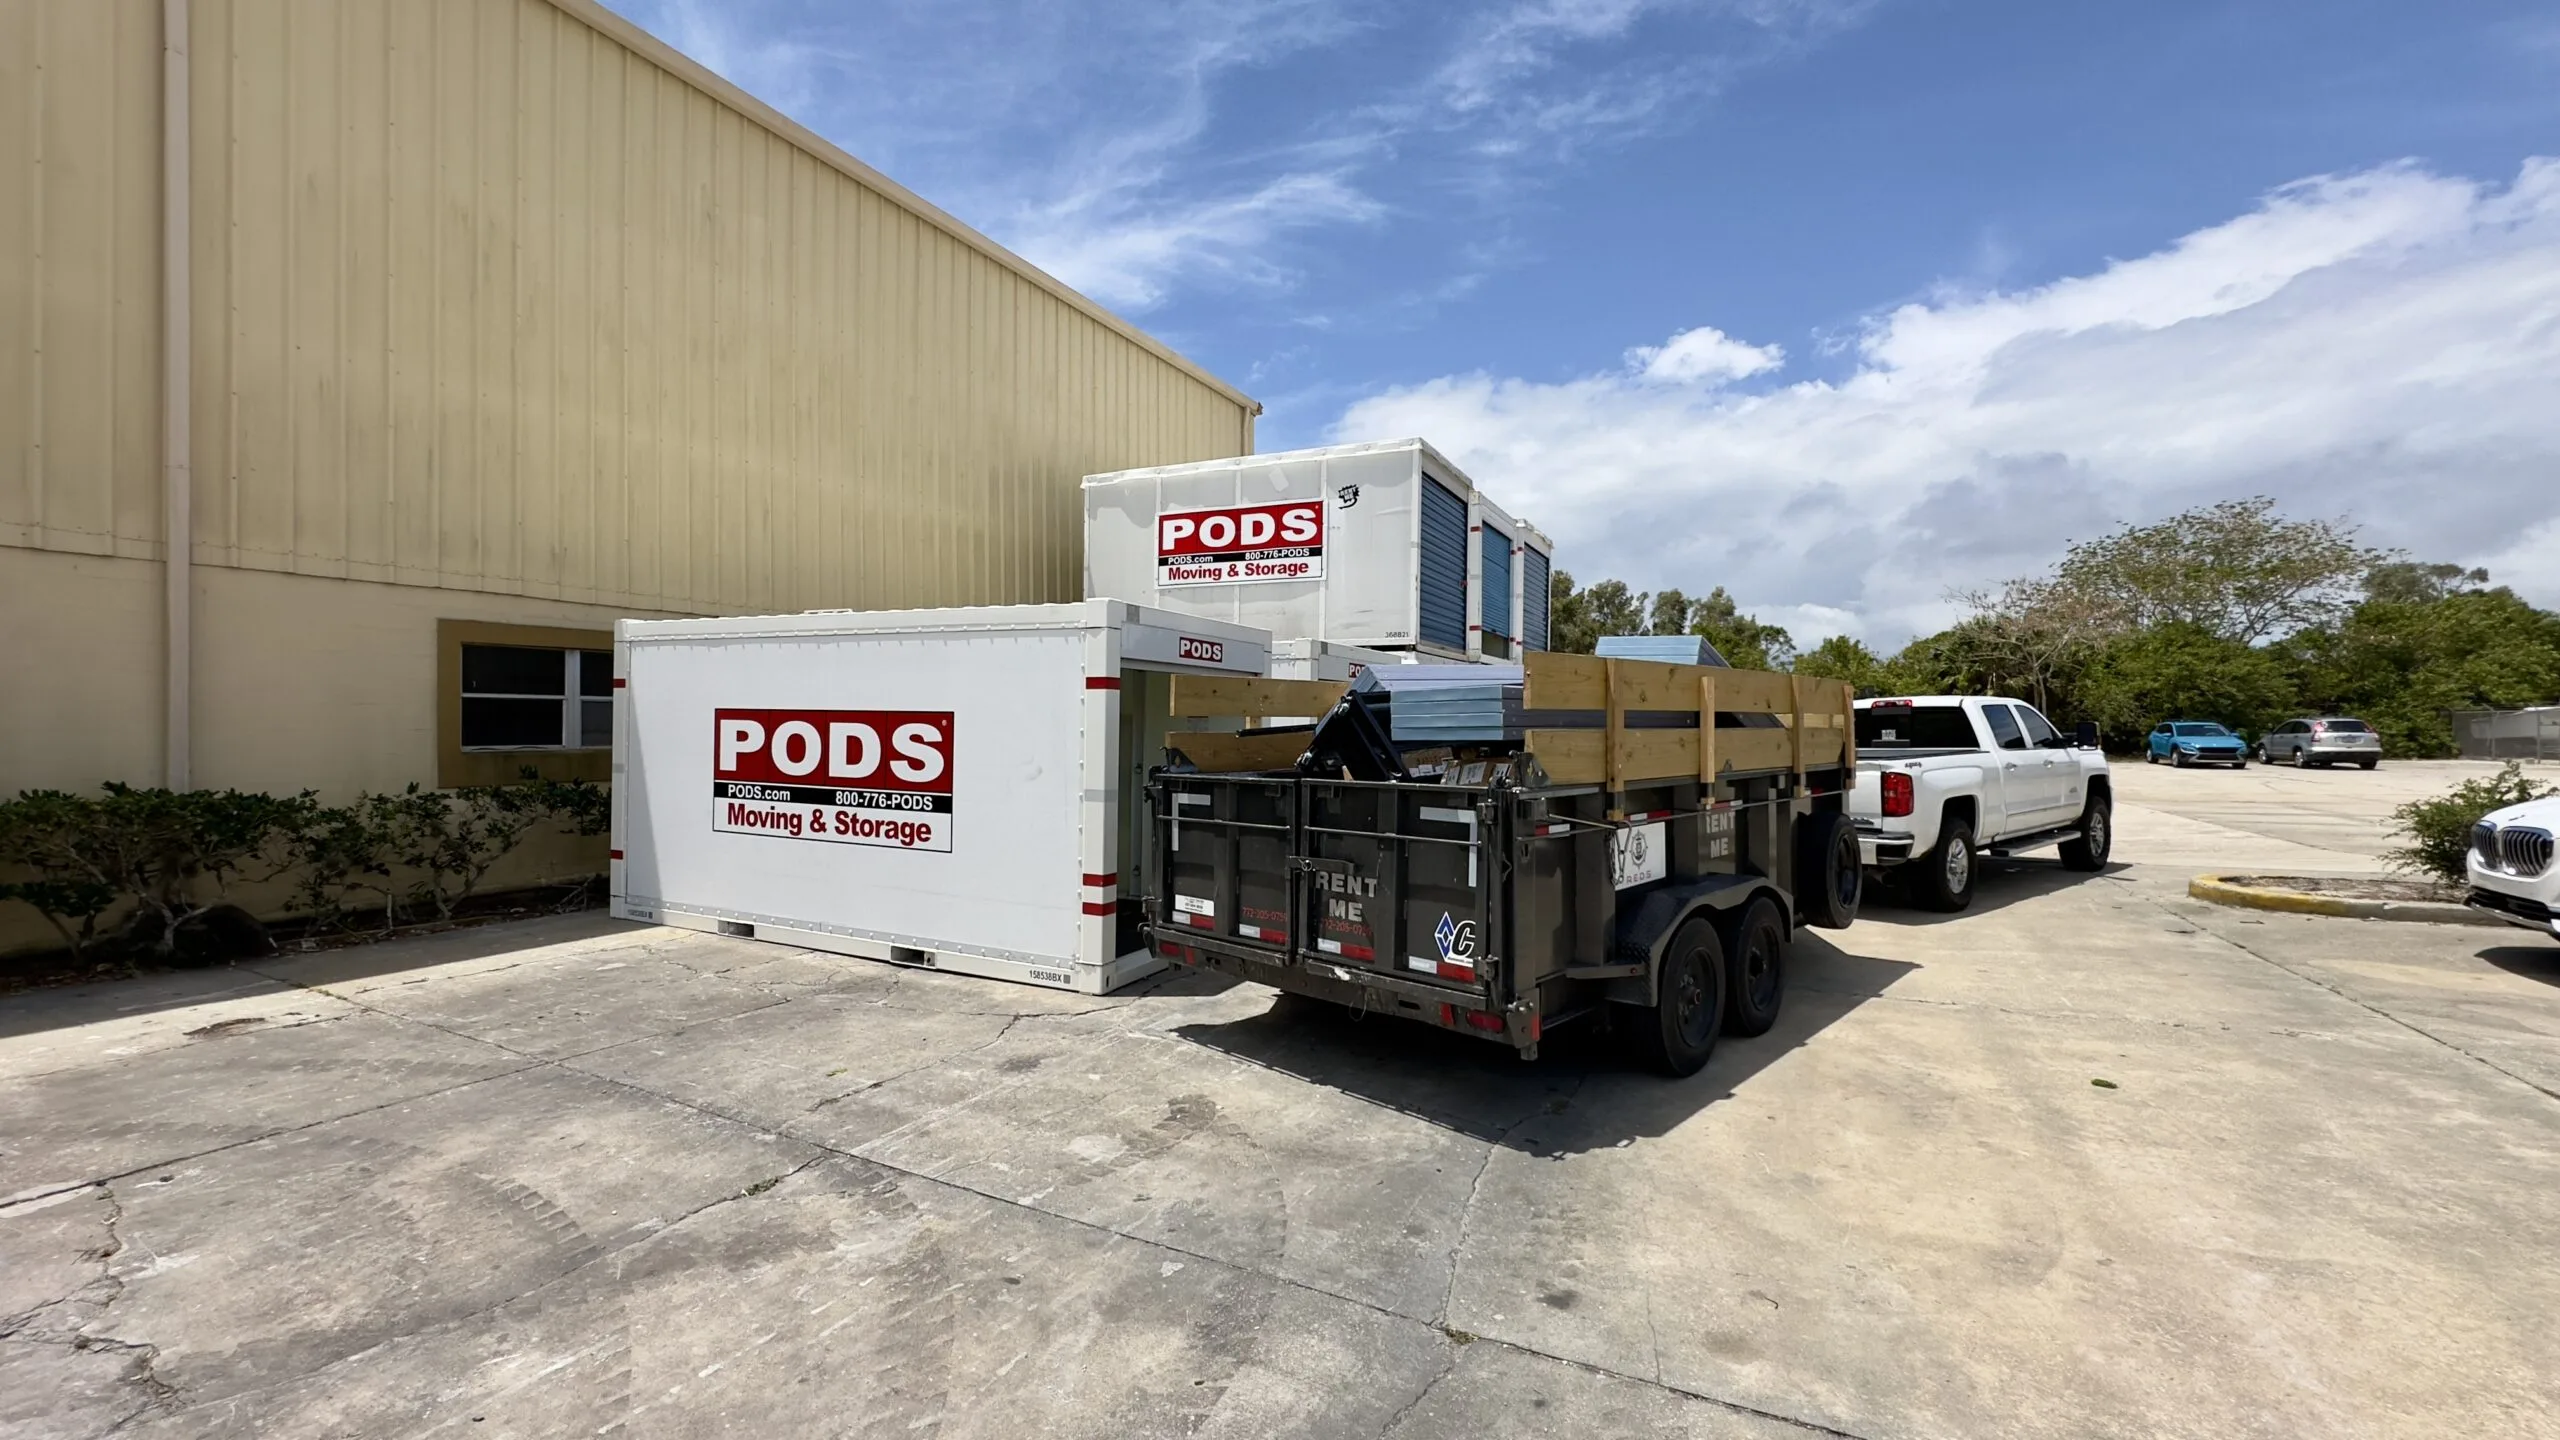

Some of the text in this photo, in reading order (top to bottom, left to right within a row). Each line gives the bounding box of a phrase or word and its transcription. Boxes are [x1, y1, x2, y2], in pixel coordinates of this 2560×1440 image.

[1162, 508, 1318, 551] PODS
[1168, 548, 1310, 565] PODS.com 800-776-PODS
[1168, 562, 1309, 581] Moving & Storage
[1180, 639, 1222, 660] PODS
[1349, 664, 1366, 677] PO
[719, 719, 945, 783] PODS
[728, 784, 933, 811] PODS.com 800-776-PODS
[727, 803, 932, 847] Moving & Storage
[1710, 837, 1729, 859] ME
[1315, 871, 1377, 898] RENT
[1328, 898, 1363, 922] ME
